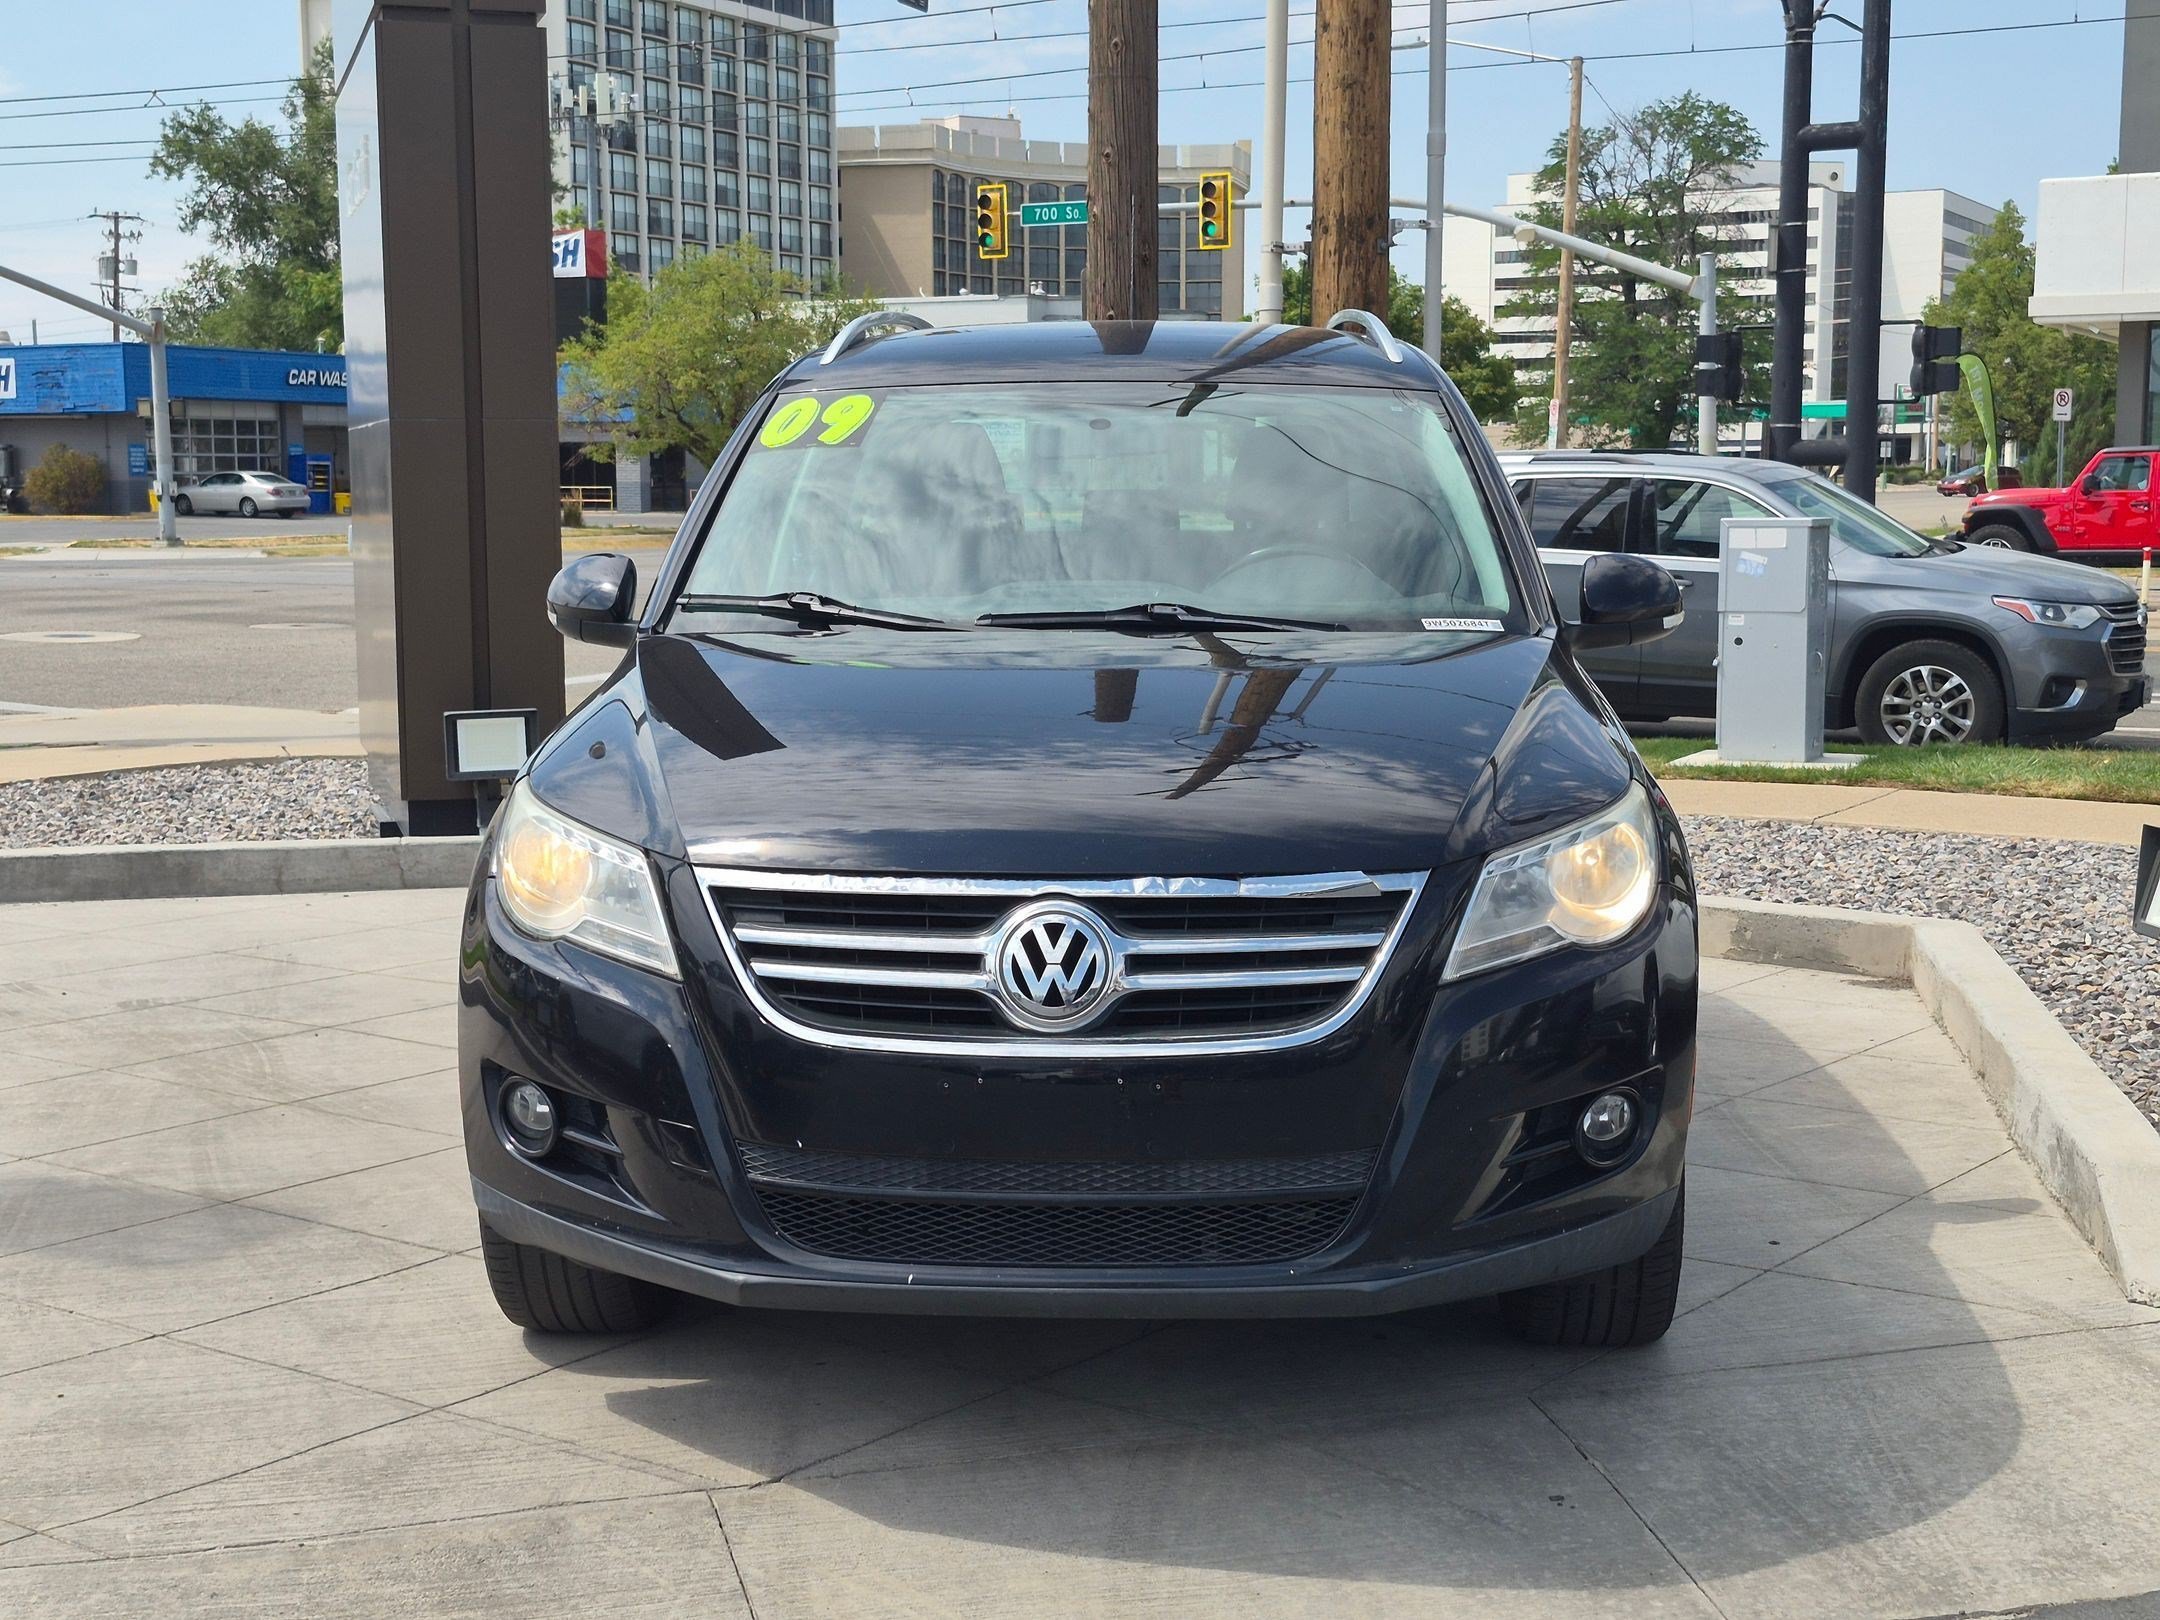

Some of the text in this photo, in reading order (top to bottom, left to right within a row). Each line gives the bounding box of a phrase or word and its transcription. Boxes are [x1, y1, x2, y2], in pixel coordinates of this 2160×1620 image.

[1034, 206, 1082, 221] 700 So.
[288, 368, 348, 387] CAR WAS
[760, 394, 875, 448] 09
[1004, 914, 1105, 1016] VW
